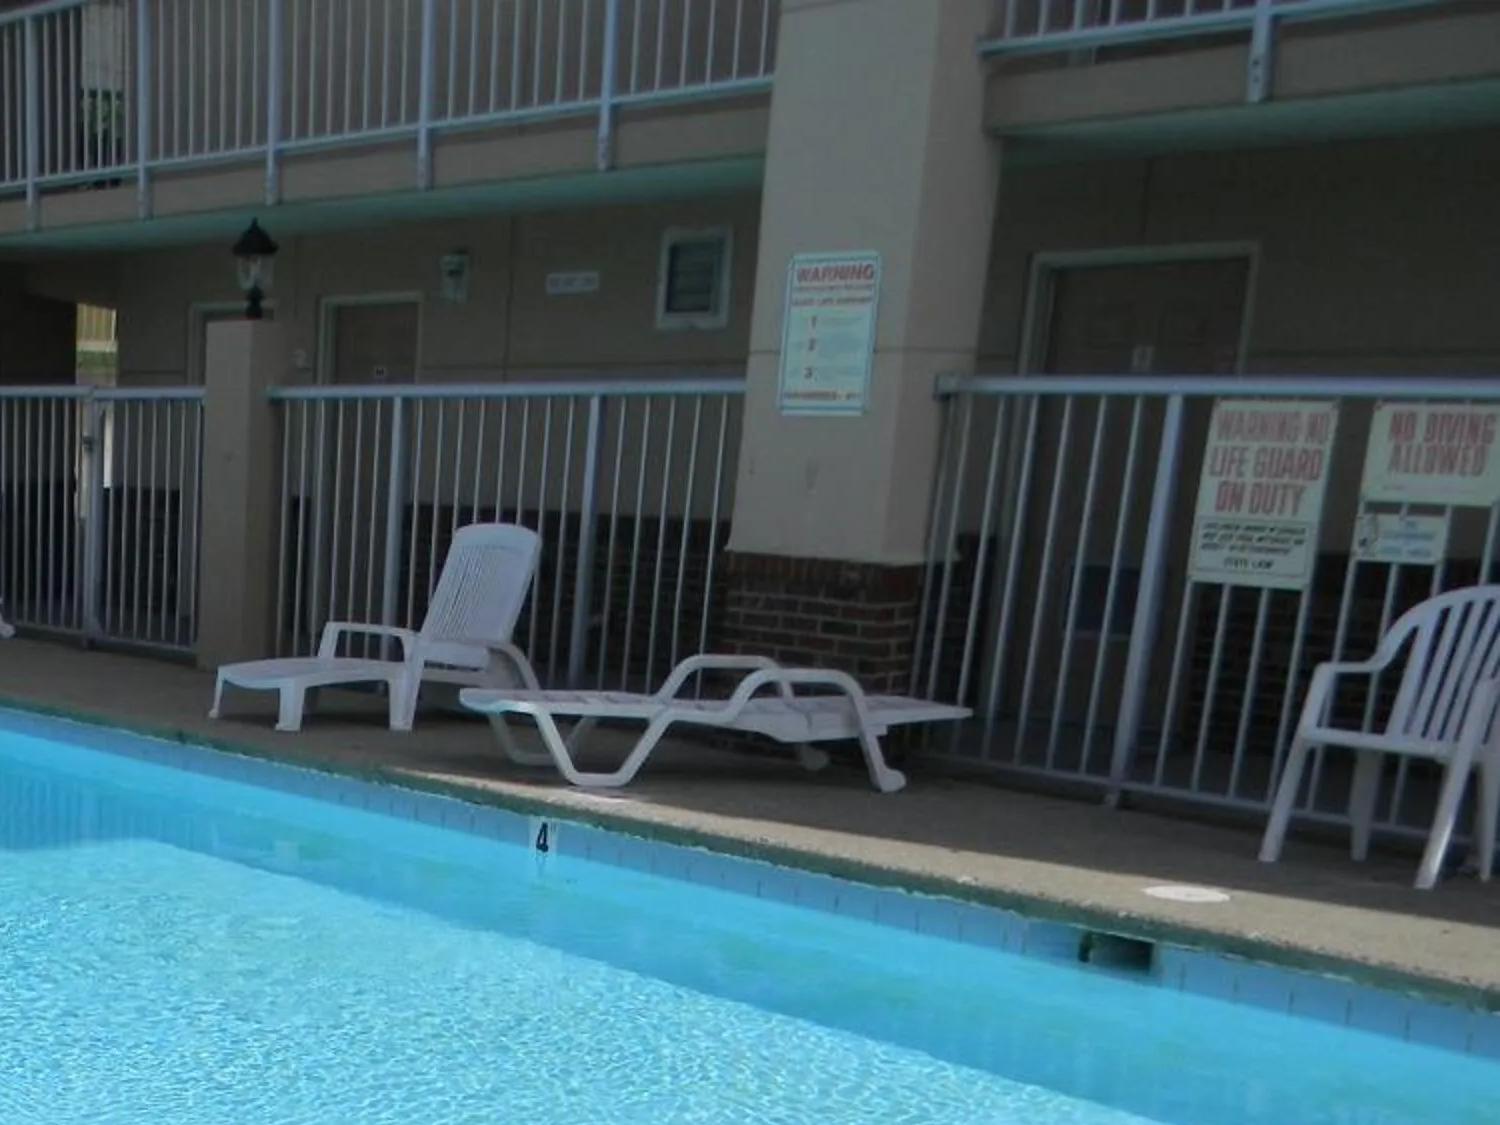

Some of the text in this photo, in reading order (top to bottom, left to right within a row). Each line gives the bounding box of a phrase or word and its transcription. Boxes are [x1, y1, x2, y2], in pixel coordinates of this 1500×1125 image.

[796, 263, 874, 283] WARNING
[1216, 410, 1330, 444] WARNING NO
[1389, 411, 1497, 445] NO DIVING
[1209, 445, 1324, 481] LIFE GUARD
[1387, 444, 1488, 477] ALLOWED
[1215, 480, 1307, 517] ON DUTY
[535, 821, 549, 852] 4
